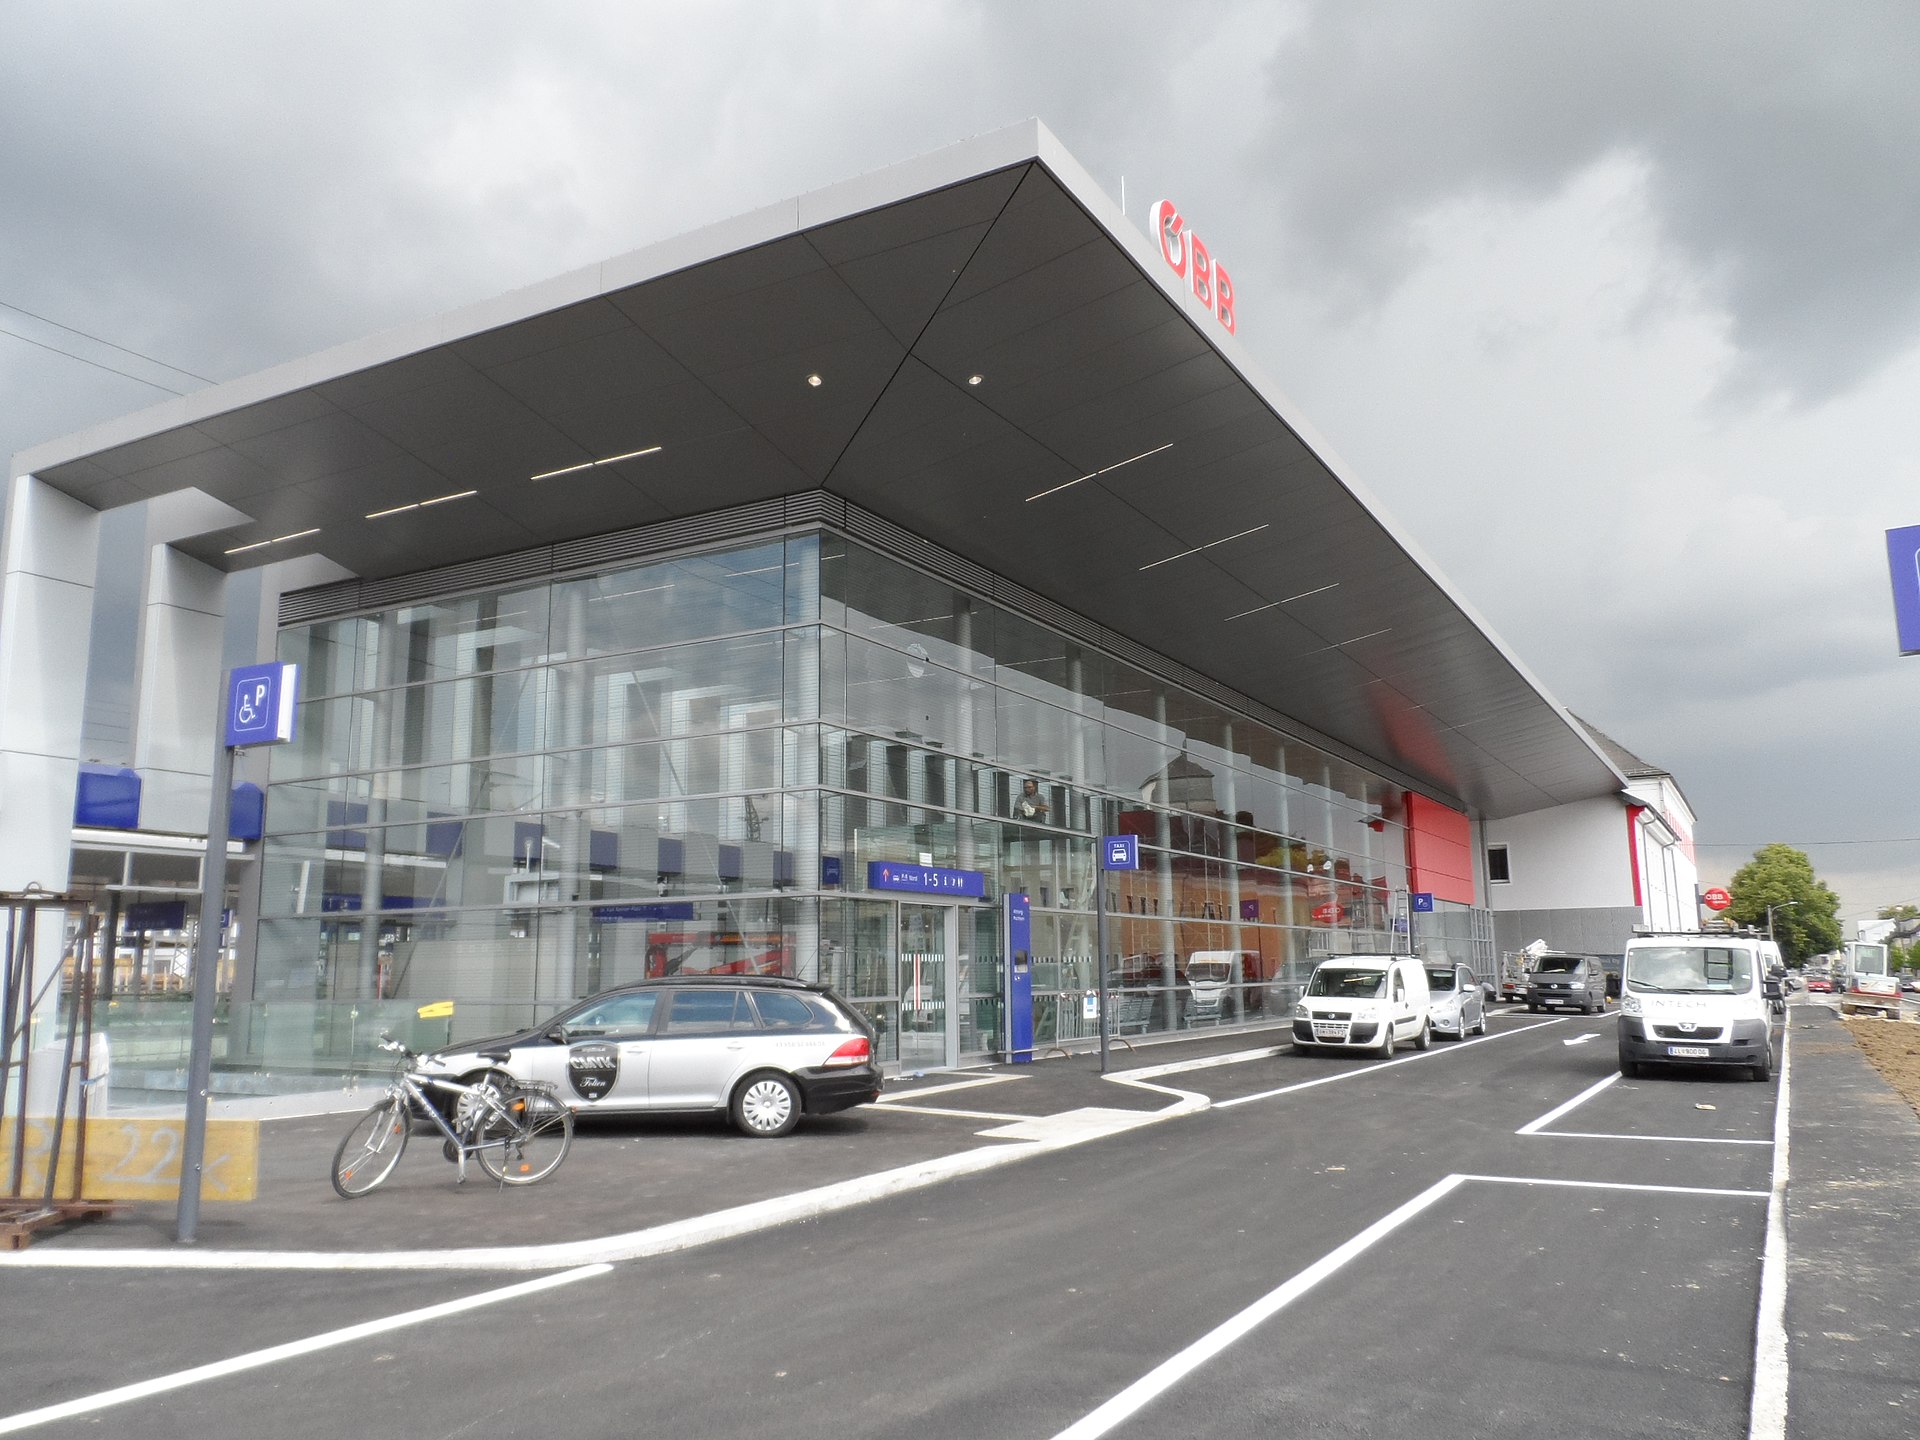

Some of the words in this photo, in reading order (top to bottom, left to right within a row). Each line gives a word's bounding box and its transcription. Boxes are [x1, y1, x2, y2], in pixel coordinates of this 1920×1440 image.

[255, 684, 265, 706] P
[924, 872, 938, 887] 1-5
[1418, 898, 1423, 906] P
[1651, 1000, 1706, 1008] INTECH
